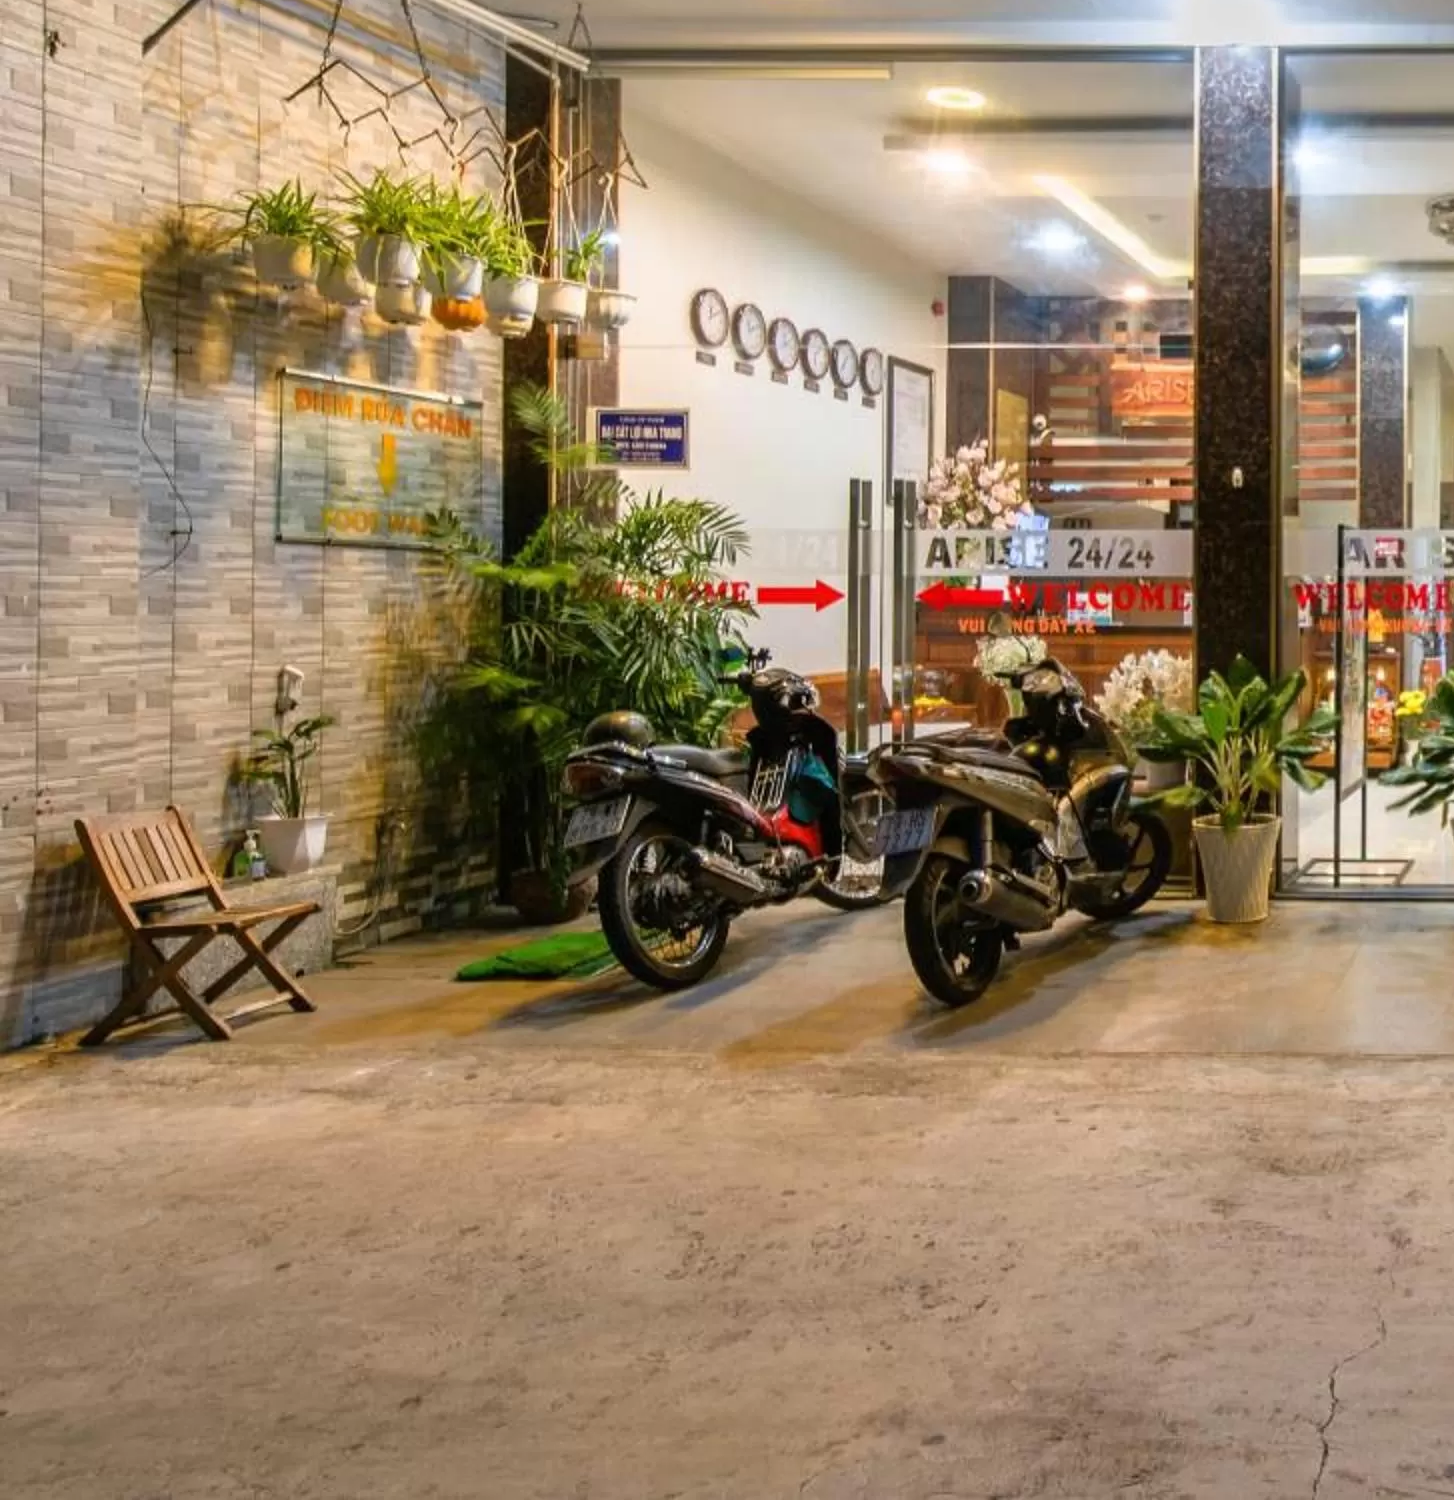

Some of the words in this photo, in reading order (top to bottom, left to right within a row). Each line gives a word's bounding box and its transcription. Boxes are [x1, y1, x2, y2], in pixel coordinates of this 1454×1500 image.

[1067, 536, 1155, 569] 24/24
[1004, 580, 1192, 613] WELCOME
[1292, 579, 1454, 613] WELCOME
